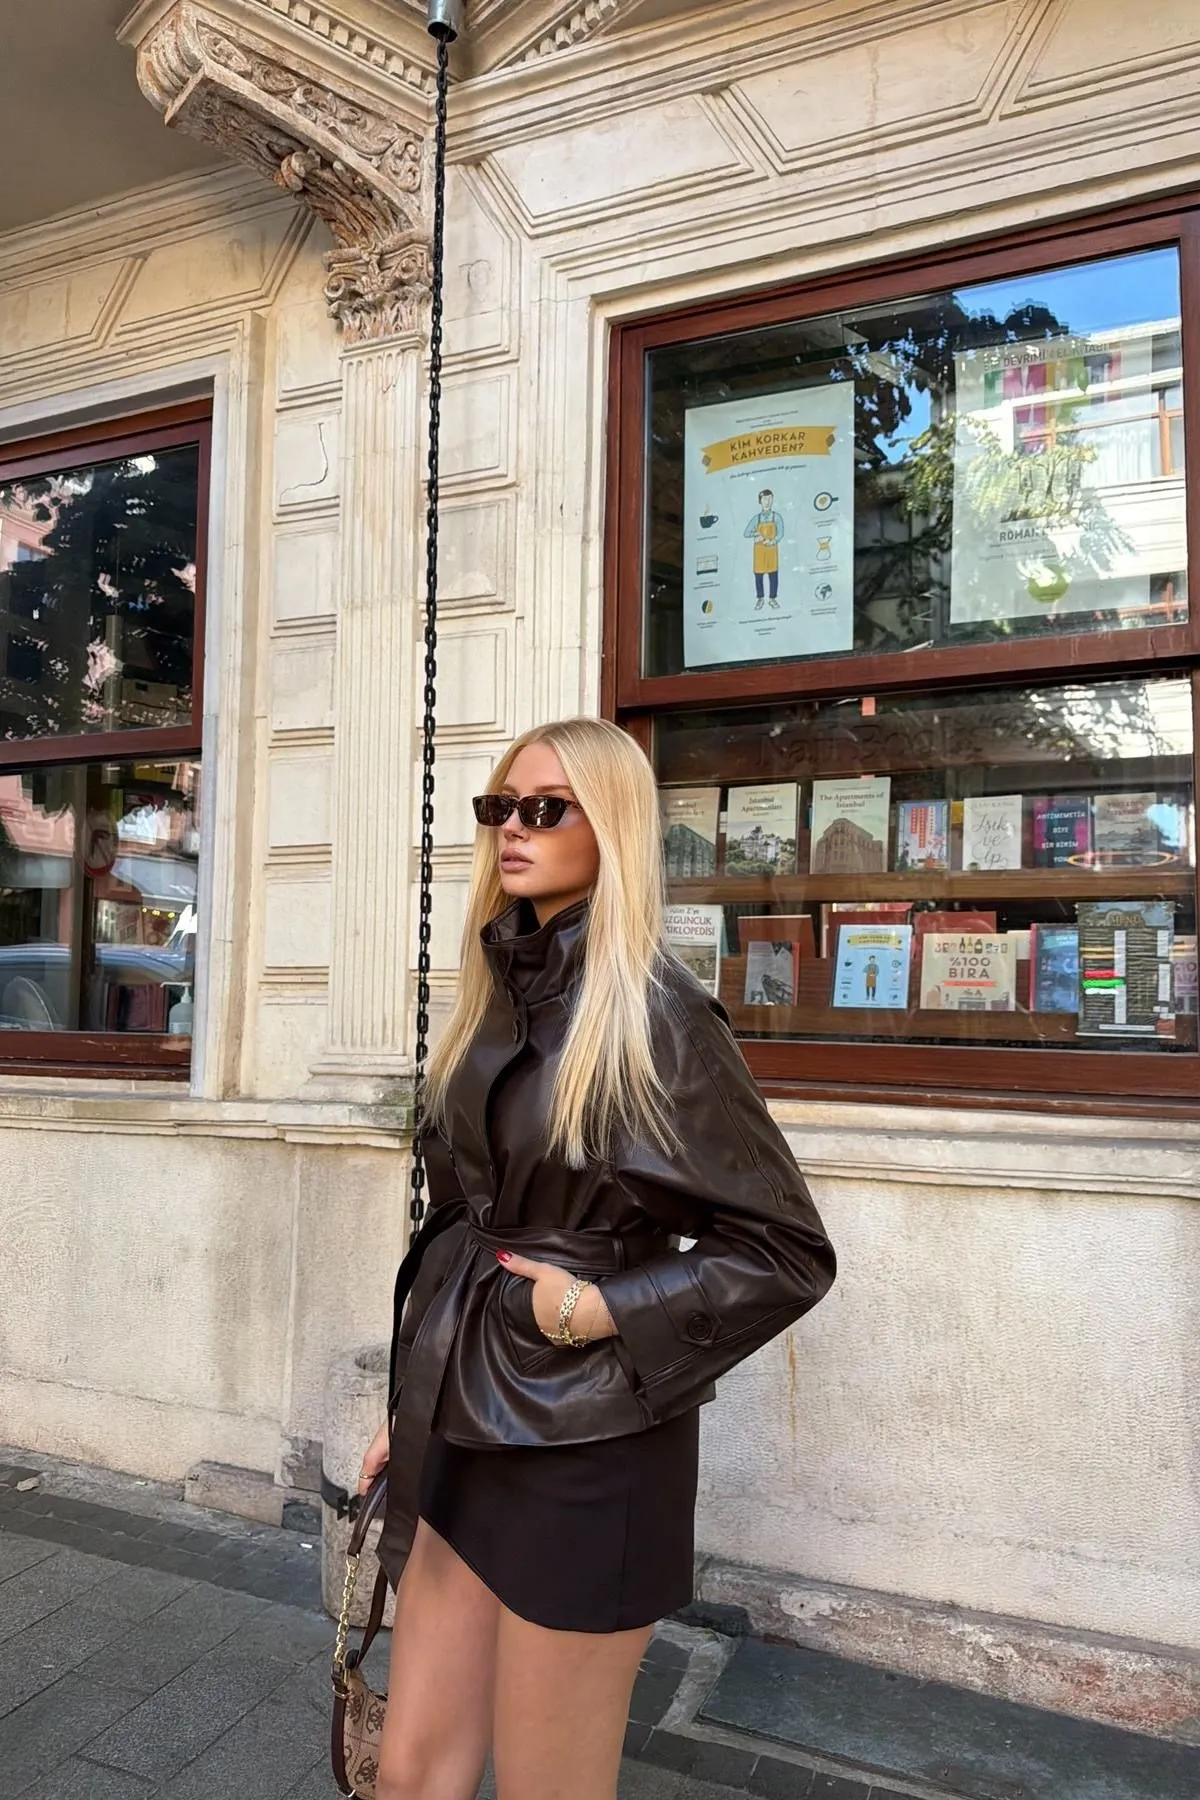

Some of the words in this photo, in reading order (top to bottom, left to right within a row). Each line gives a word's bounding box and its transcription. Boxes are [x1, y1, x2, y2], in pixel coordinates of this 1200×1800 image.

[756, 431, 805, 446] KORKAR
[731, 442, 804, 462] KAHVEDEN?
[950, 956, 991, 967] %100
